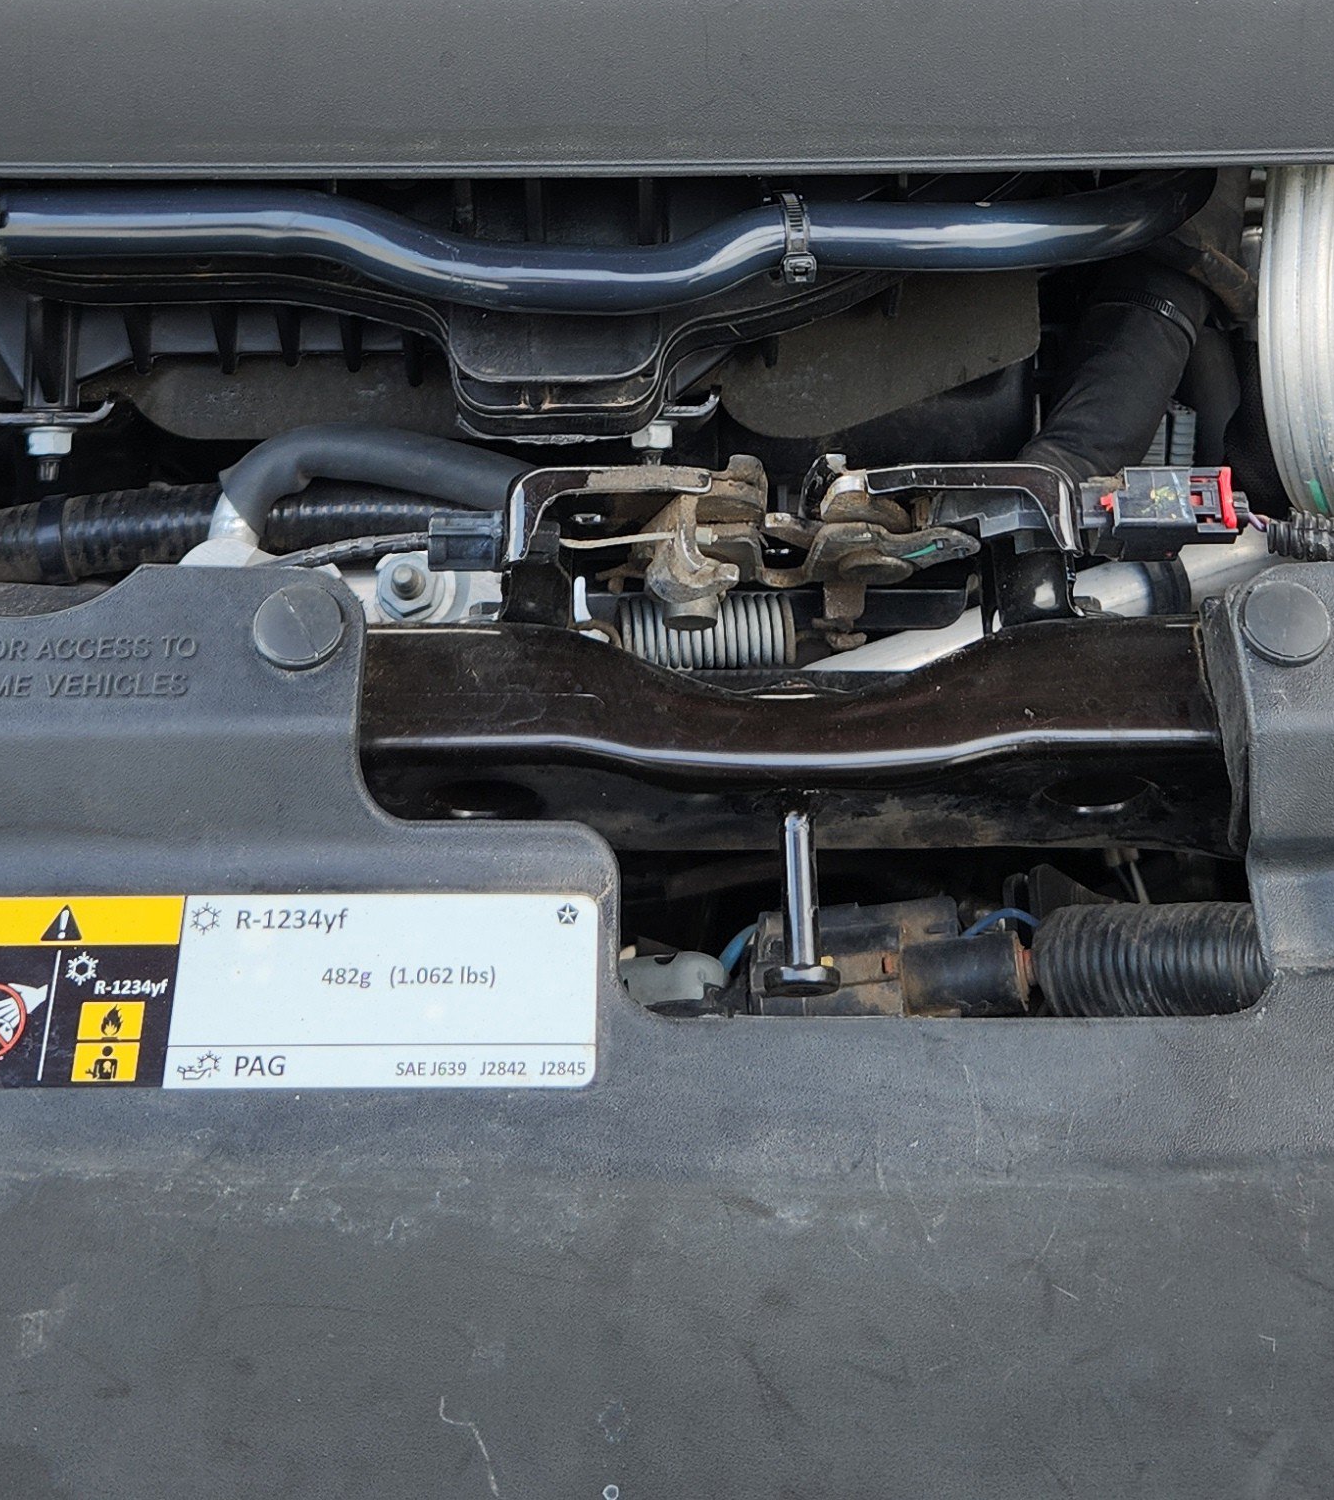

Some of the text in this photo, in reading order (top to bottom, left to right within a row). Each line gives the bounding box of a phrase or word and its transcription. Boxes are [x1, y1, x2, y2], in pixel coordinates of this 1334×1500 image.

[35, 636, 153, 661] ACCESS
[161, 636, 198, 659] TO
[44, 673, 189, 698] VEHICLES
[235, 907, 349, 934] R-1234yf
[93, 977, 169, 997] R-1234yf
[321, 964, 497, 989] 482g (1.062 lbs)
[234, 1055, 286, 1078] PAG
[395, 1060, 587, 1078] SAE J639 J2842 J2845
